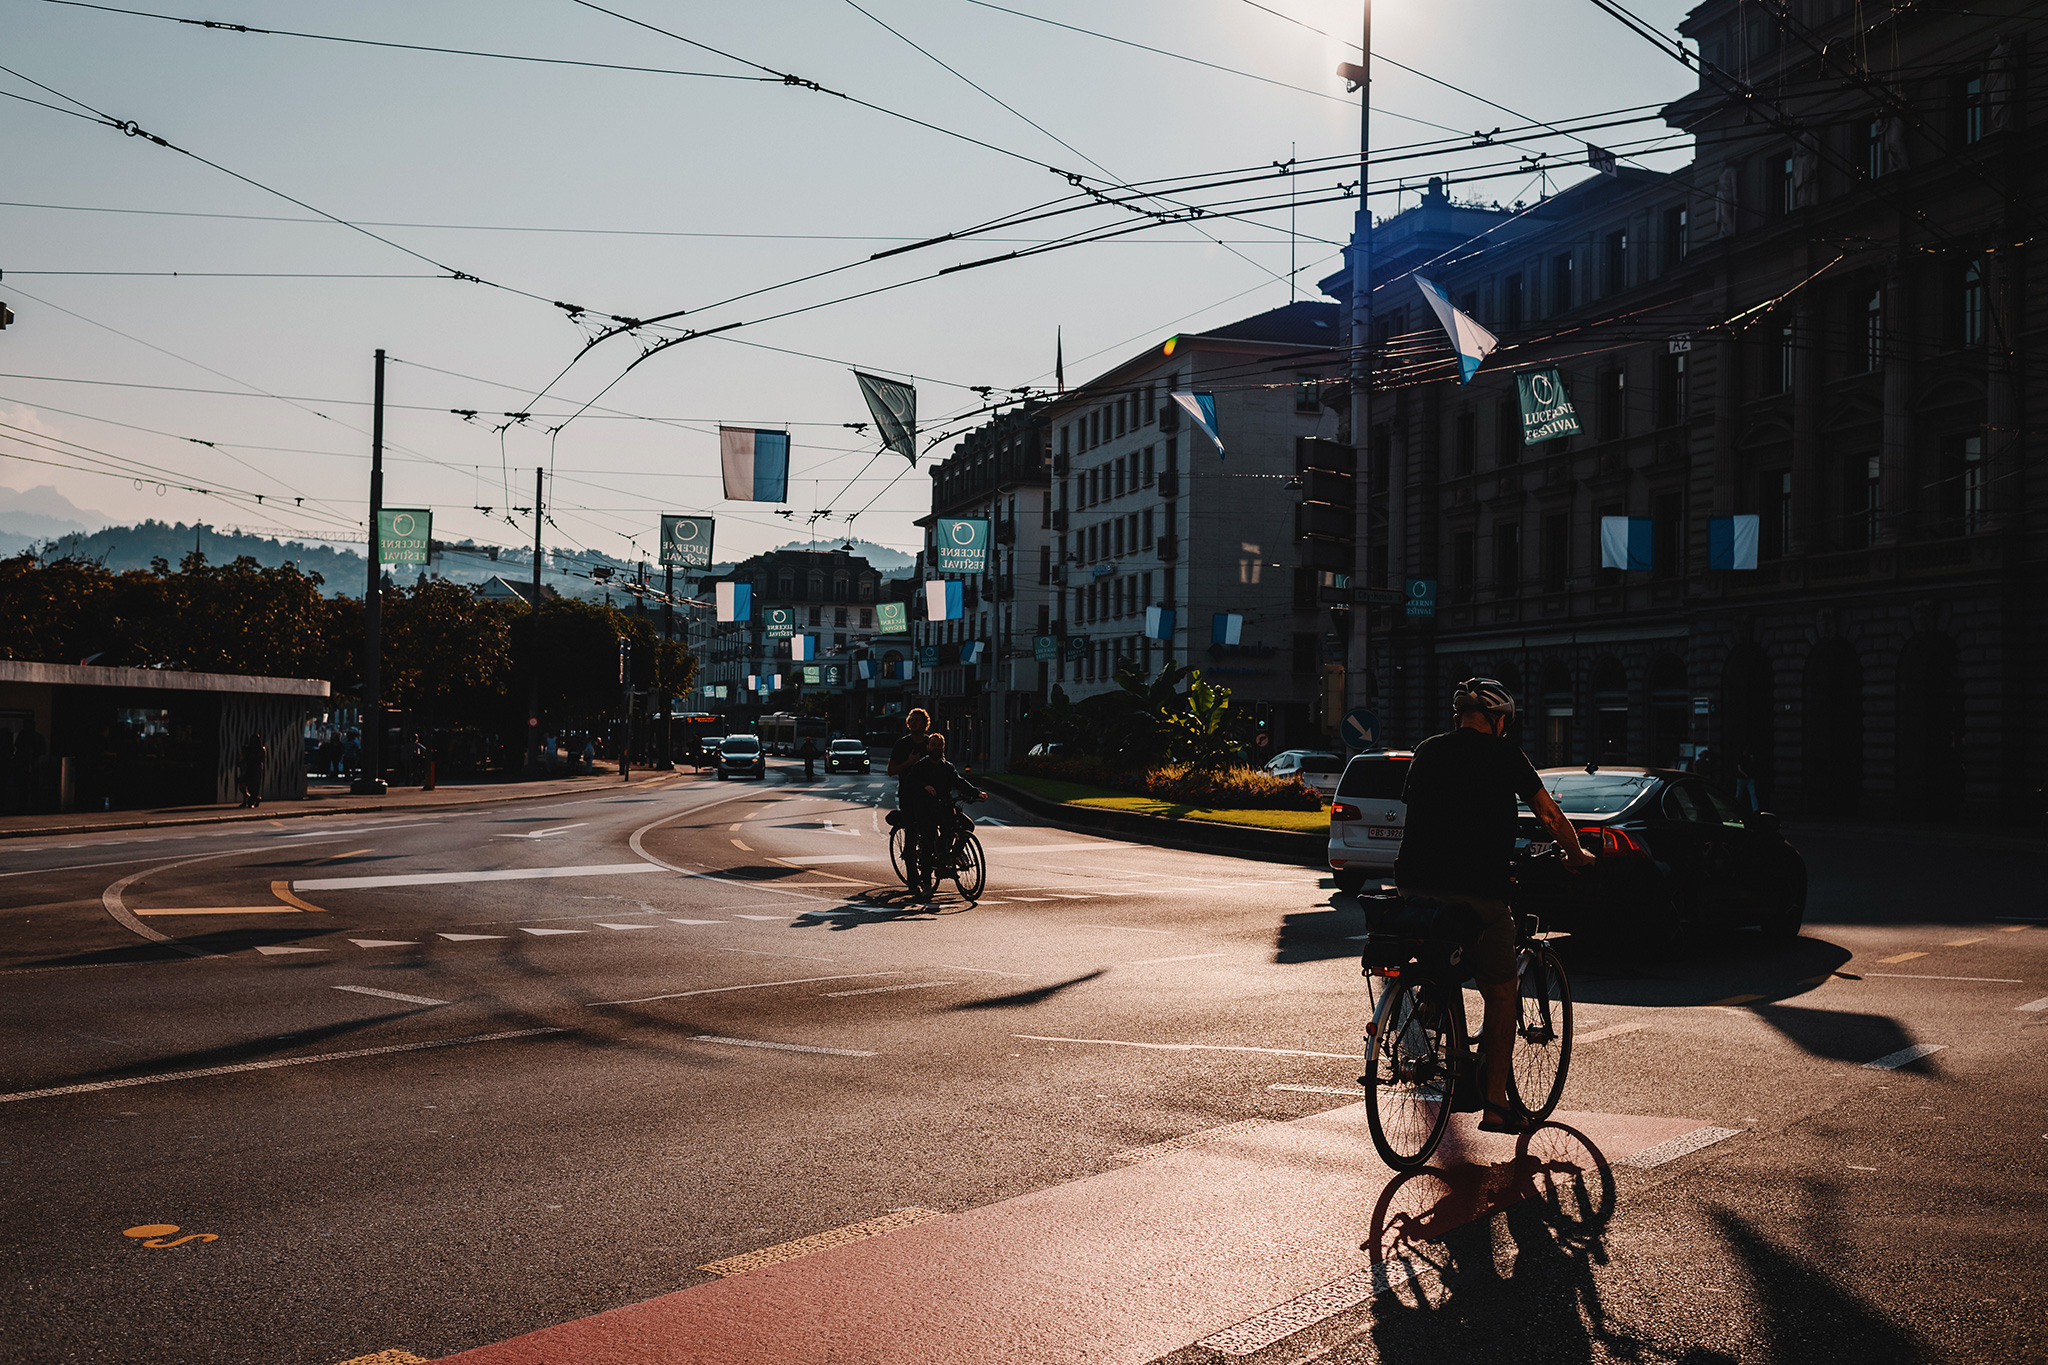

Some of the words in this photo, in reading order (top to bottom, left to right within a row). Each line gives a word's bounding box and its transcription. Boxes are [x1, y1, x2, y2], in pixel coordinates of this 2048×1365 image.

[1673, 336, 1688, 351] A2
[1525, 403, 1576, 426] LUCERNE
[1526, 418, 1579, 440] FESTIVAL
